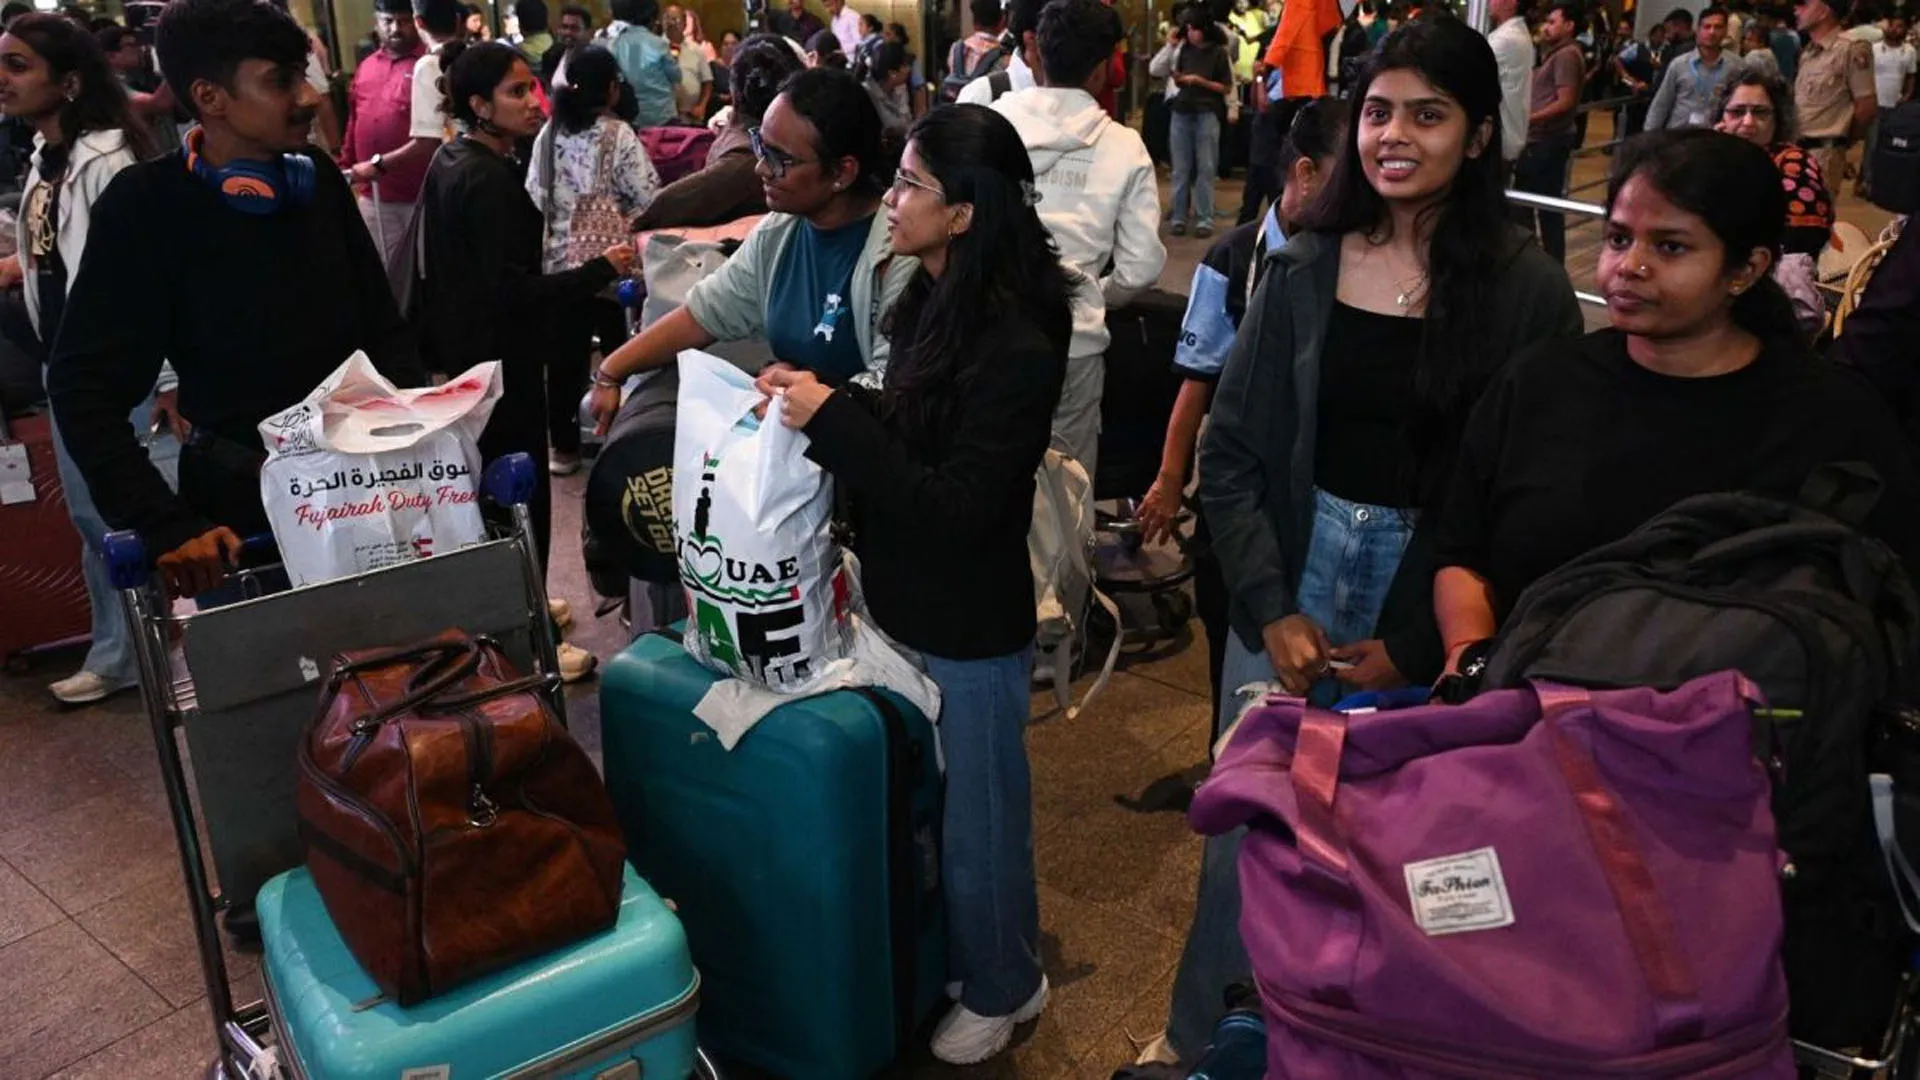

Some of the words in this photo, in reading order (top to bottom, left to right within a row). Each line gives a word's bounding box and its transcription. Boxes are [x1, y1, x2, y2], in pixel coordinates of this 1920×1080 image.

[290, 470, 346, 498] الحرة
[351, 462, 423, 488] الفجيرة
[295, 493, 385, 530] Fujairah
[388, 490, 432, 513] Duty
[627, 475, 662, 521] SET
[647, 523, 678, 553] GO
[725, 557, 799, 583] UAE
